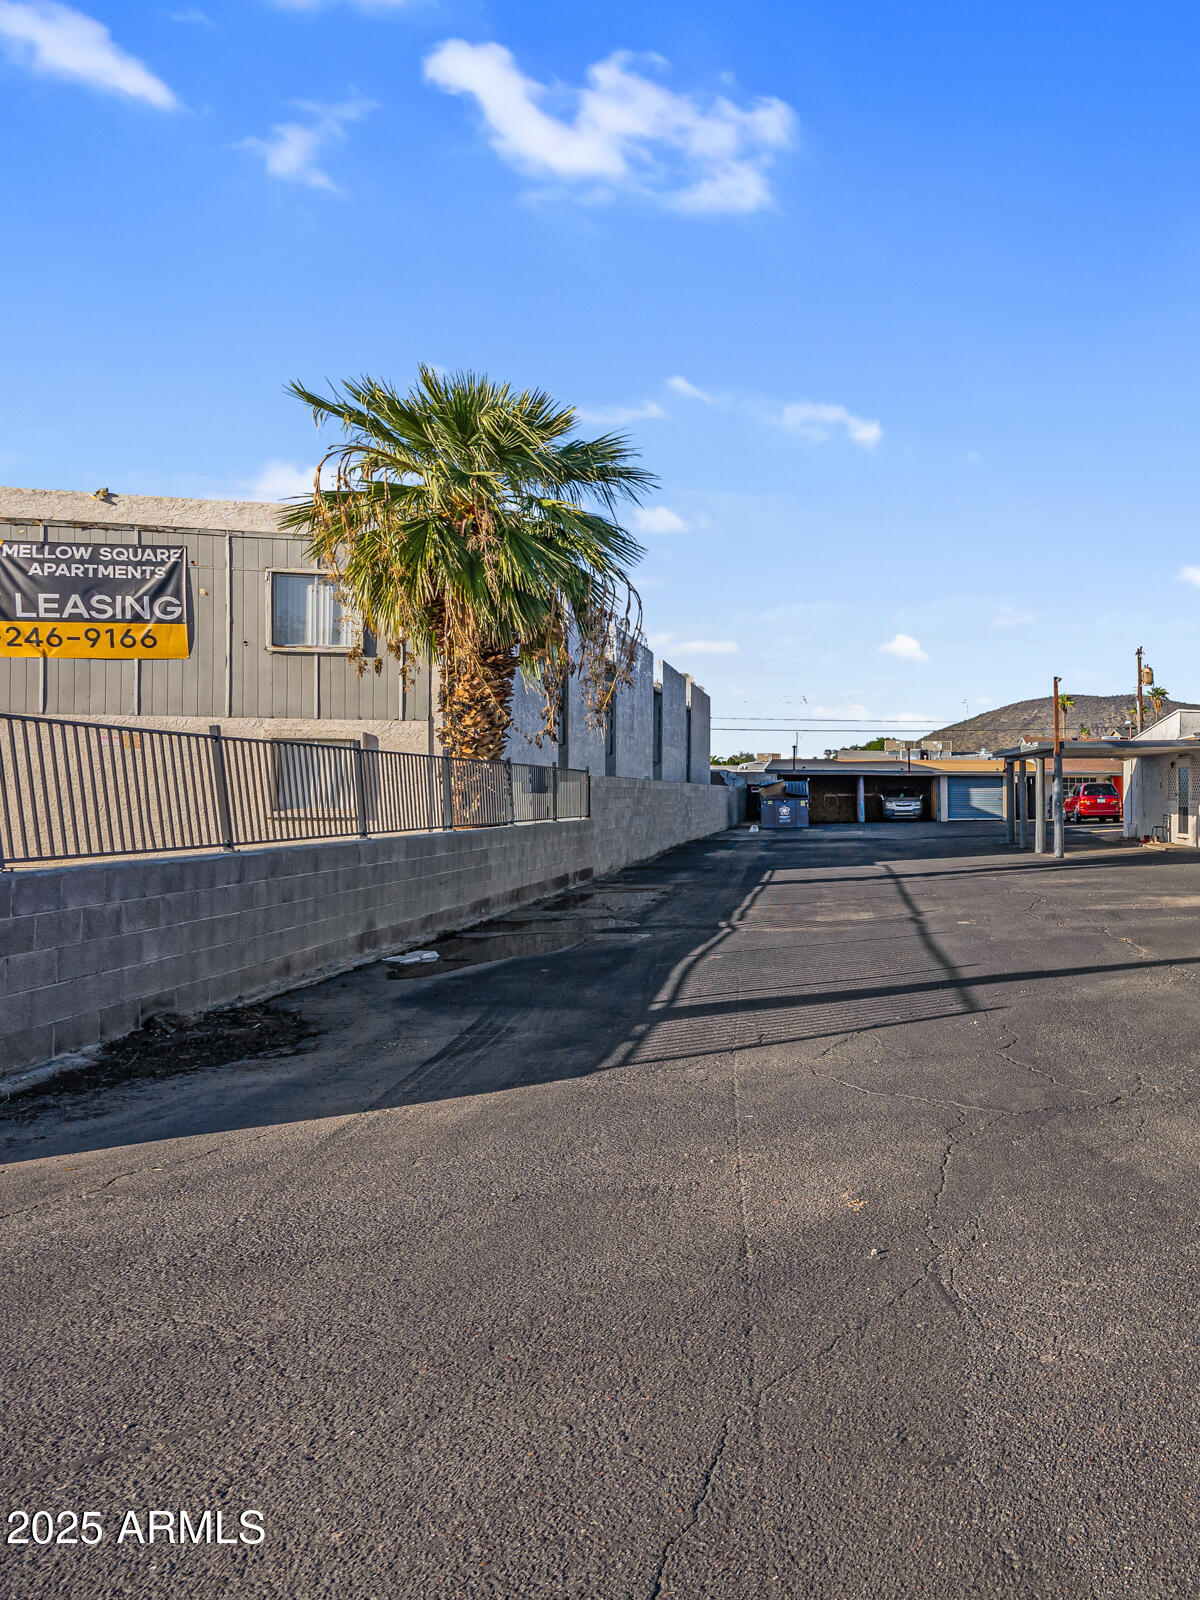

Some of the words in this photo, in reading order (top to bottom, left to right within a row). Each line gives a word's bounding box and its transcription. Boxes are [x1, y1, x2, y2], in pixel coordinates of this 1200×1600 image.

[2, 544, 93, 560] MELLOW
[99, 547, 182, 562] SQUARE
[27, 562, 166, 579] APARTMENTS
[15, 592, 182, 620] LEASING
[0, 626, 158, 649] 246-9166
